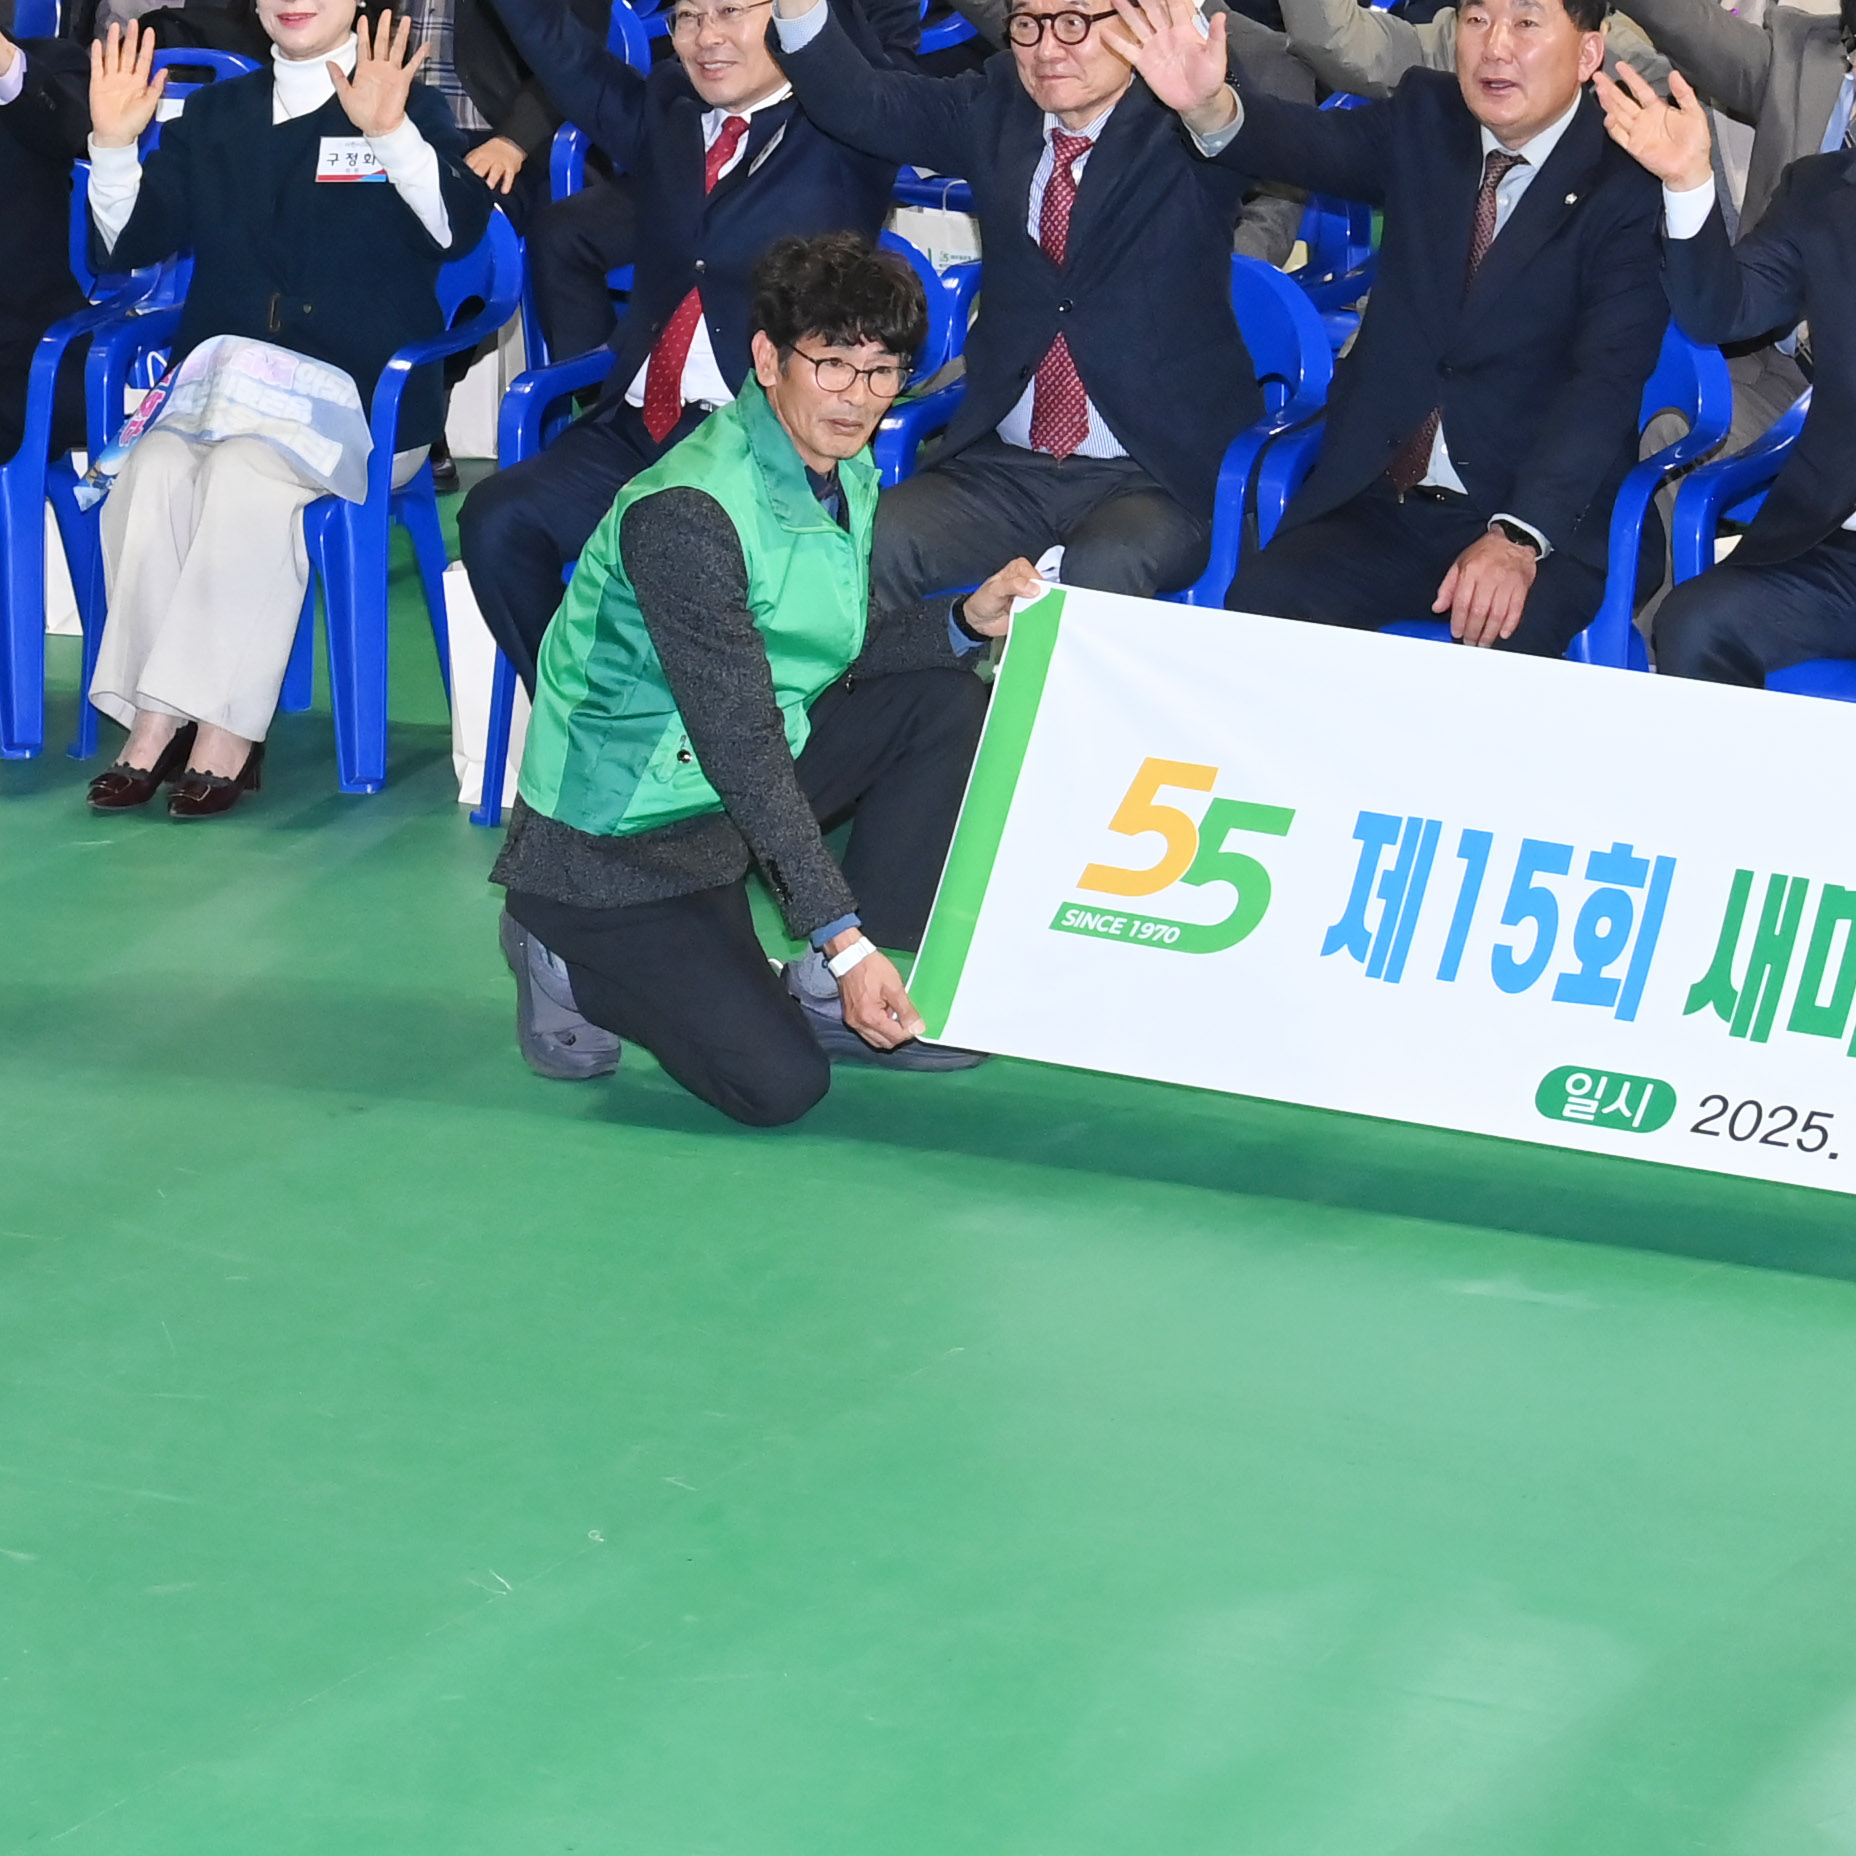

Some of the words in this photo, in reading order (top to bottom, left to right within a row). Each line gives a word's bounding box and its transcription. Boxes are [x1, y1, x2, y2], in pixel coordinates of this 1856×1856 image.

[326, 152, 376, 167] 구정화
[1076, 756, 1296, 956] 55
[1060, 908, 1128, 935] SINCE
[1129, 920, 1181, 944] 1970
[1319, 809, 1678, 1023] 제15회
[1561, 1071, 1657, 1131] 일시
[1689, 1093, 1840, 1162] 2025.
